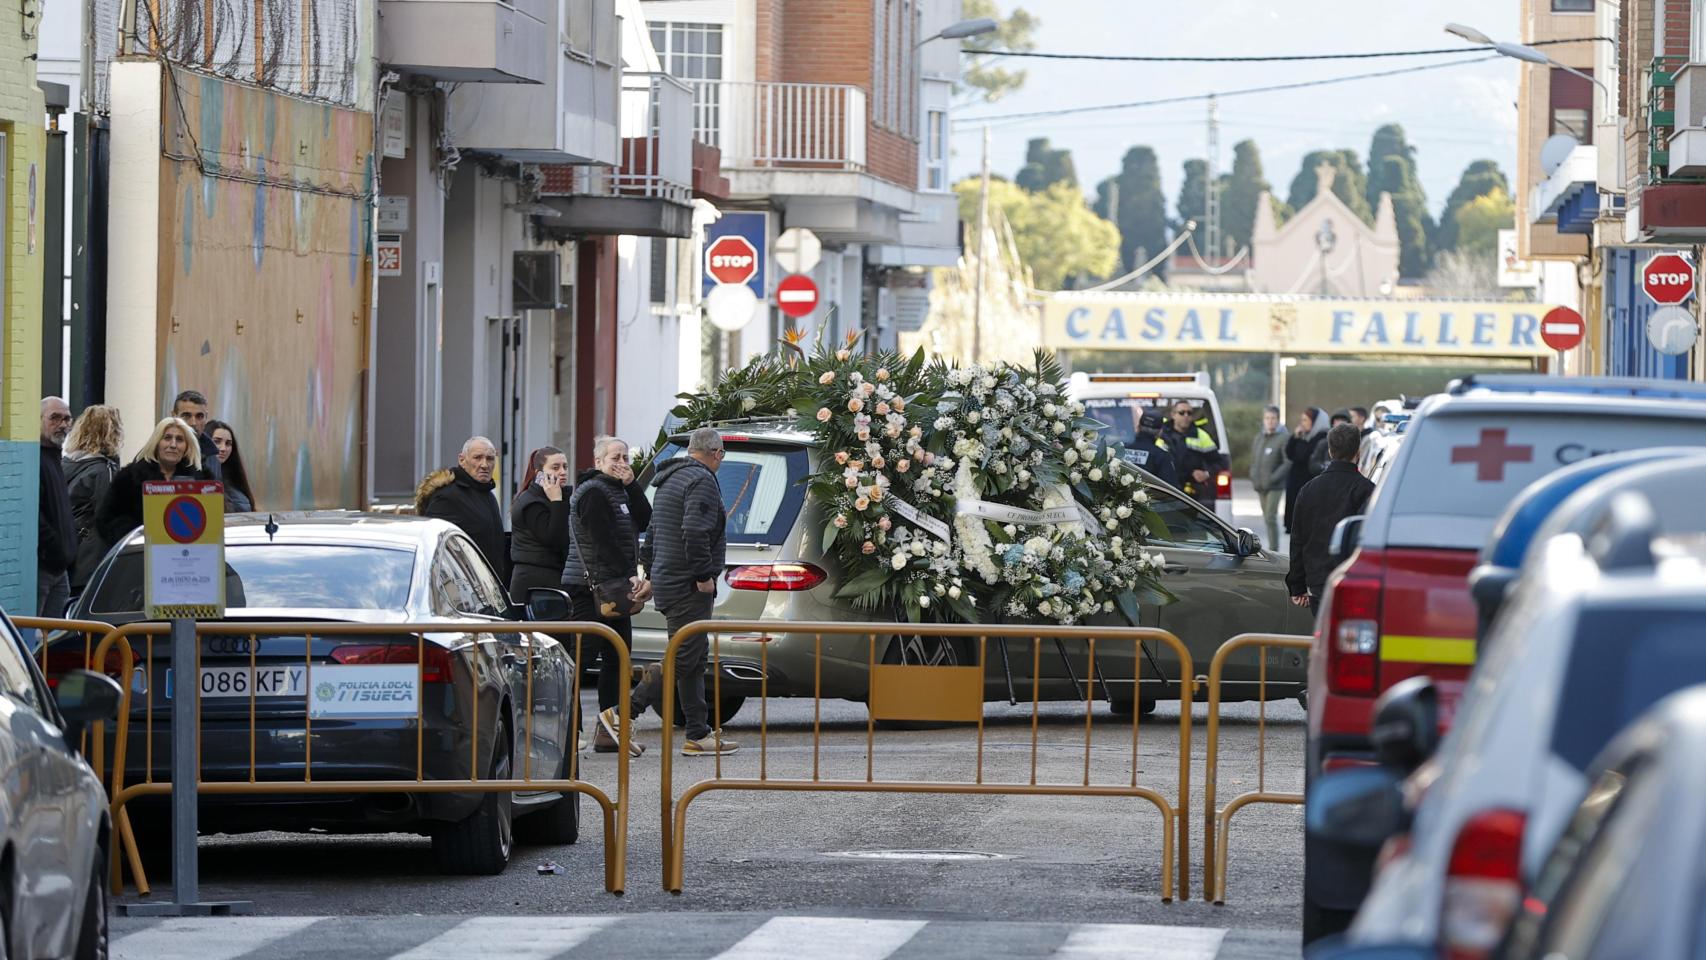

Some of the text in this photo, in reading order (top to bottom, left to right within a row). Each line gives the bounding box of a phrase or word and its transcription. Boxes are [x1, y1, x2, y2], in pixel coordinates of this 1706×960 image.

[711, 255, 752, 268] STOP
[1648, 273, 1689, 285] STOP
[1064, 306, 1539, 348] CASAL FALLER
[201, 670, 302, 693] 086 KFY
[338, 681, 414, 690] POLICIA LOCAL
[359, 690, 412, 702] SUECA
